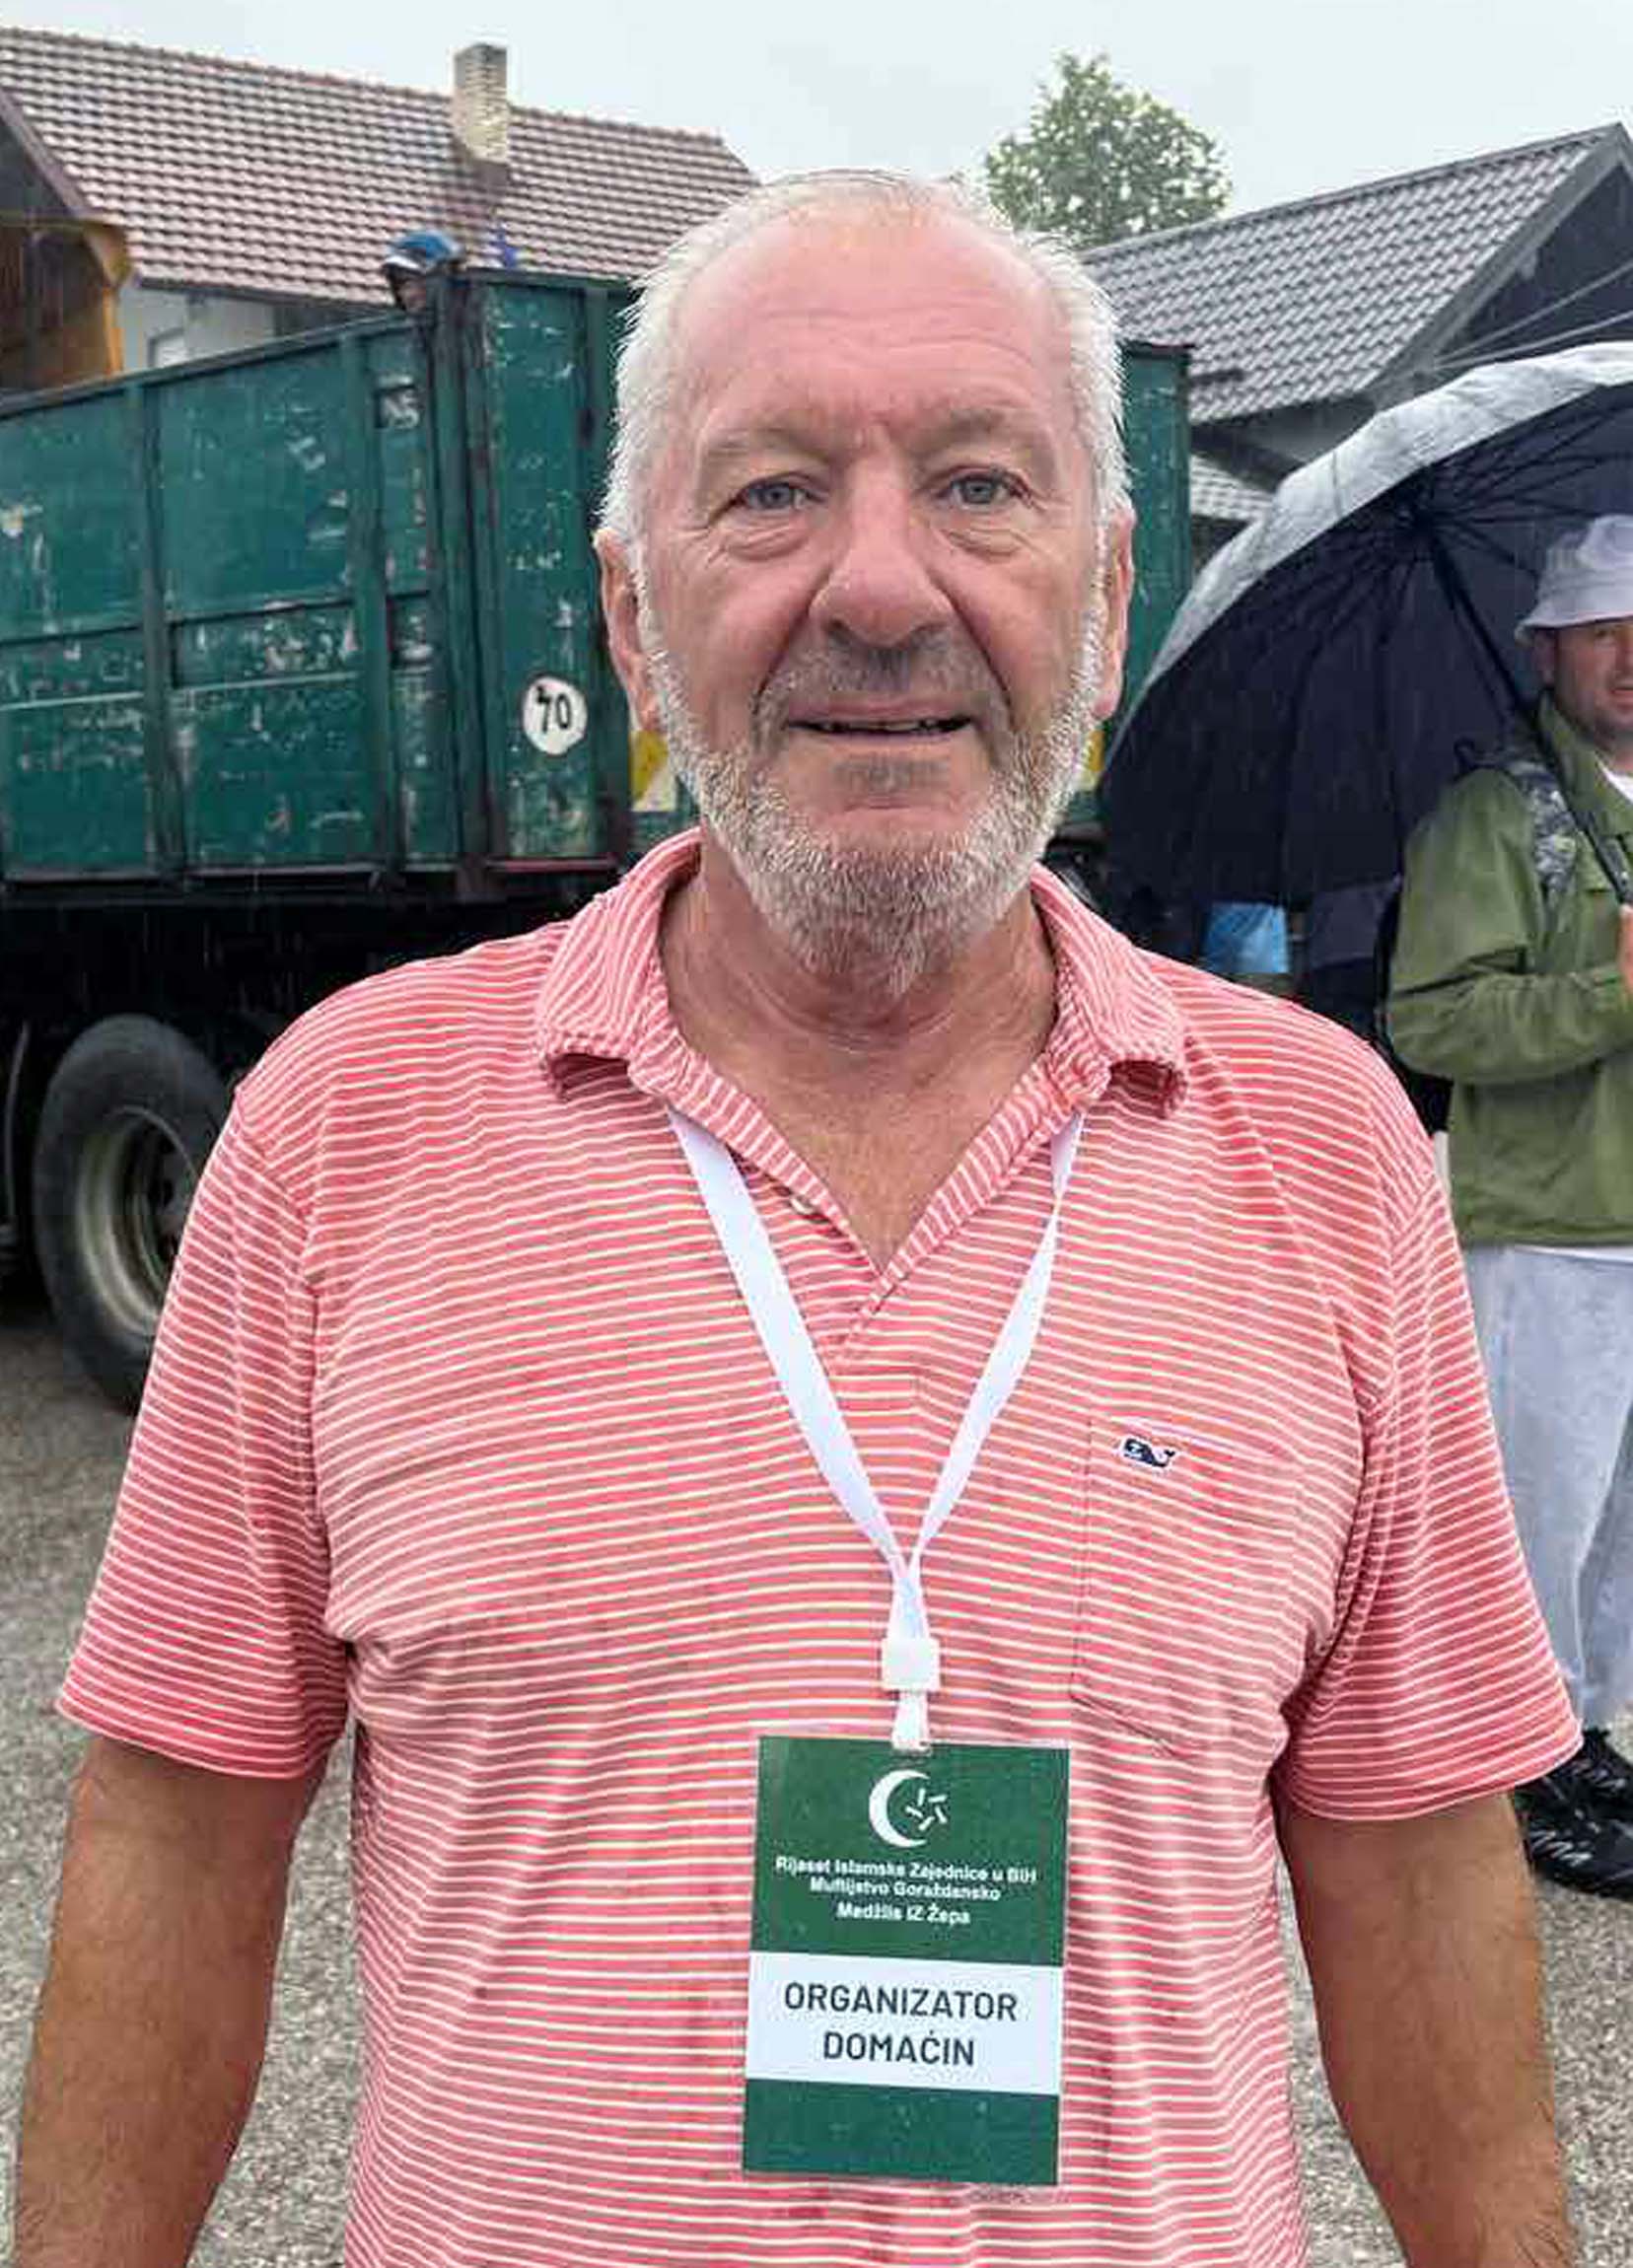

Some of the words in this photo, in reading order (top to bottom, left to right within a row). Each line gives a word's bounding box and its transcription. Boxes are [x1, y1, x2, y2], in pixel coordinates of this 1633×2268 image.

[992, 1869, 1004, 1881] u
[906, 1903, 925, 1921] IZ
[927, 1902, 970, 1925] Žepa
[784, 1982, 1019, 2021] ORGANIZATOR
[823, 2029, 974, 2067] DOMAĆIN
